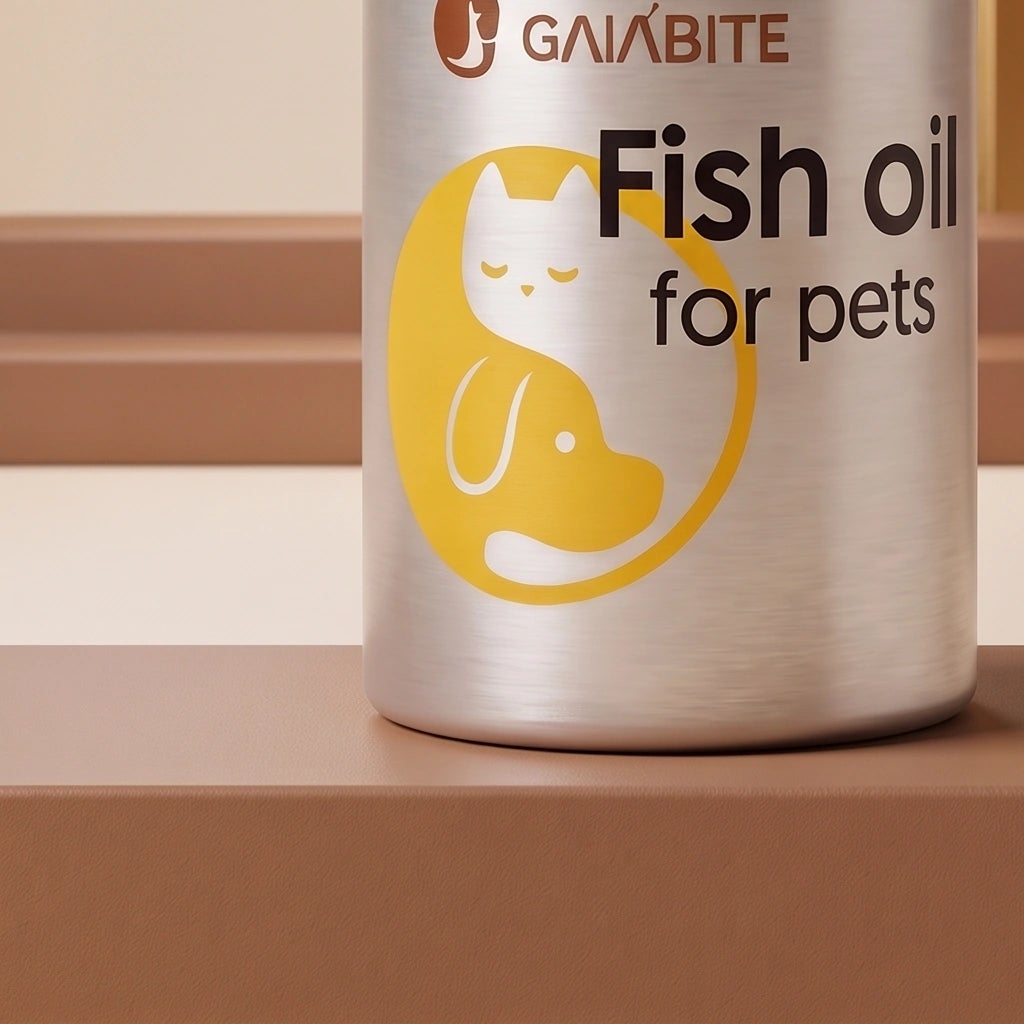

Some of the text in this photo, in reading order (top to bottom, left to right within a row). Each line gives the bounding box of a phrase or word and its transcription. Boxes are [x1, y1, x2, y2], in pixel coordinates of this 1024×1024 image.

[599, 114, 957, 241] Fish oil
[649, 268, 936, 363] for pets
